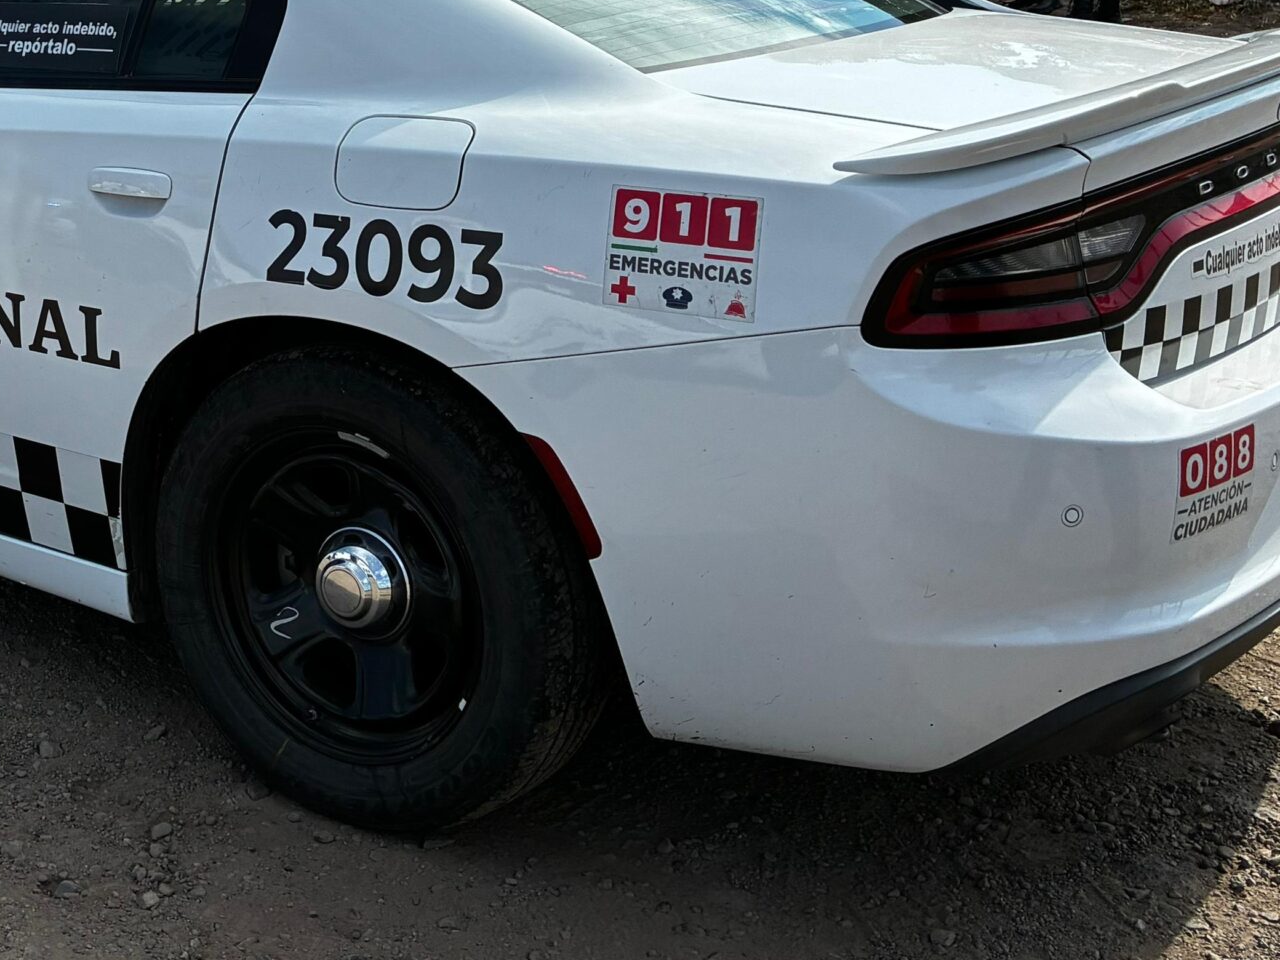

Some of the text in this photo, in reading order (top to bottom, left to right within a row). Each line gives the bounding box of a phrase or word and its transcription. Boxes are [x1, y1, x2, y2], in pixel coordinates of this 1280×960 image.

[8, 37, 76, 57] repórtalo
[33, 21, 59, 34] acto
[62, 21, 117, 39] indebido,
[623, 198, 742, 242] 911
[266, 209, 504, 310] 23093
[609, 253, 752, 286] EMERGENCIAS
[1205, 241, 1246, 275] Cualquier
[1247, 233, 1263, 260] acto
[1186, 434, 1250, 489] 088
[1174, 497, 1248, 540] CIUDADANA
[1188, 480, 1244, 516] ATENCIÓN
